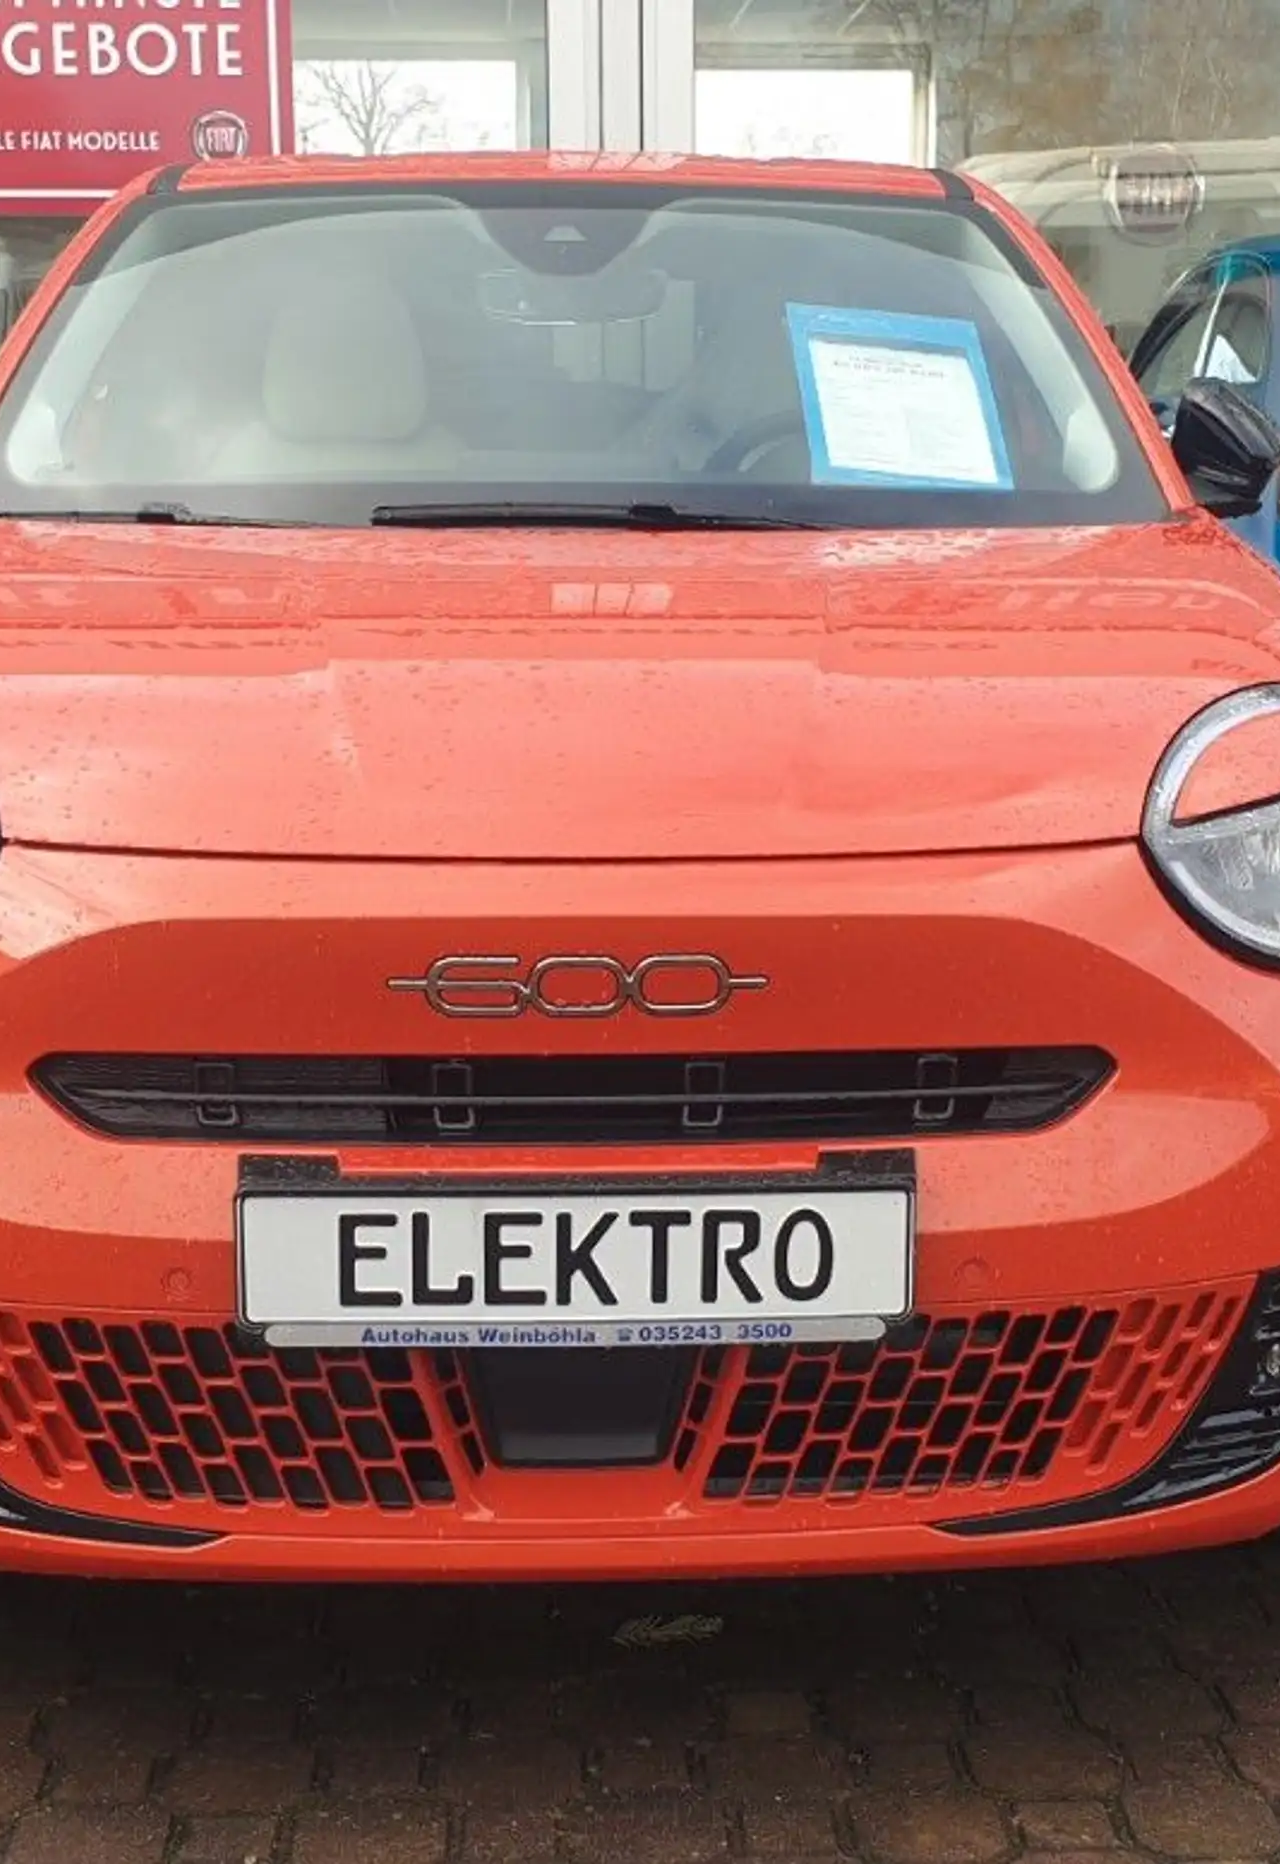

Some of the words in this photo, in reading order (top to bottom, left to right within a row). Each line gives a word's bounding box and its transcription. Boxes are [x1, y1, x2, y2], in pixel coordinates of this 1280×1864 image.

[20, 130, 63, 150] FIAT
[68, 130, 160, 151] MODELLE
[424, 953, 733, 1018] 600
[337, 1208, 834, 1307] ELEKTRO
[361, 1327, 469, 1344] Autohaus
[478, 1326, 596, 1344] Weinböhla
[639, 1325, 721, 1341] 035243
[737, 1323, 792, 1339] 3500
